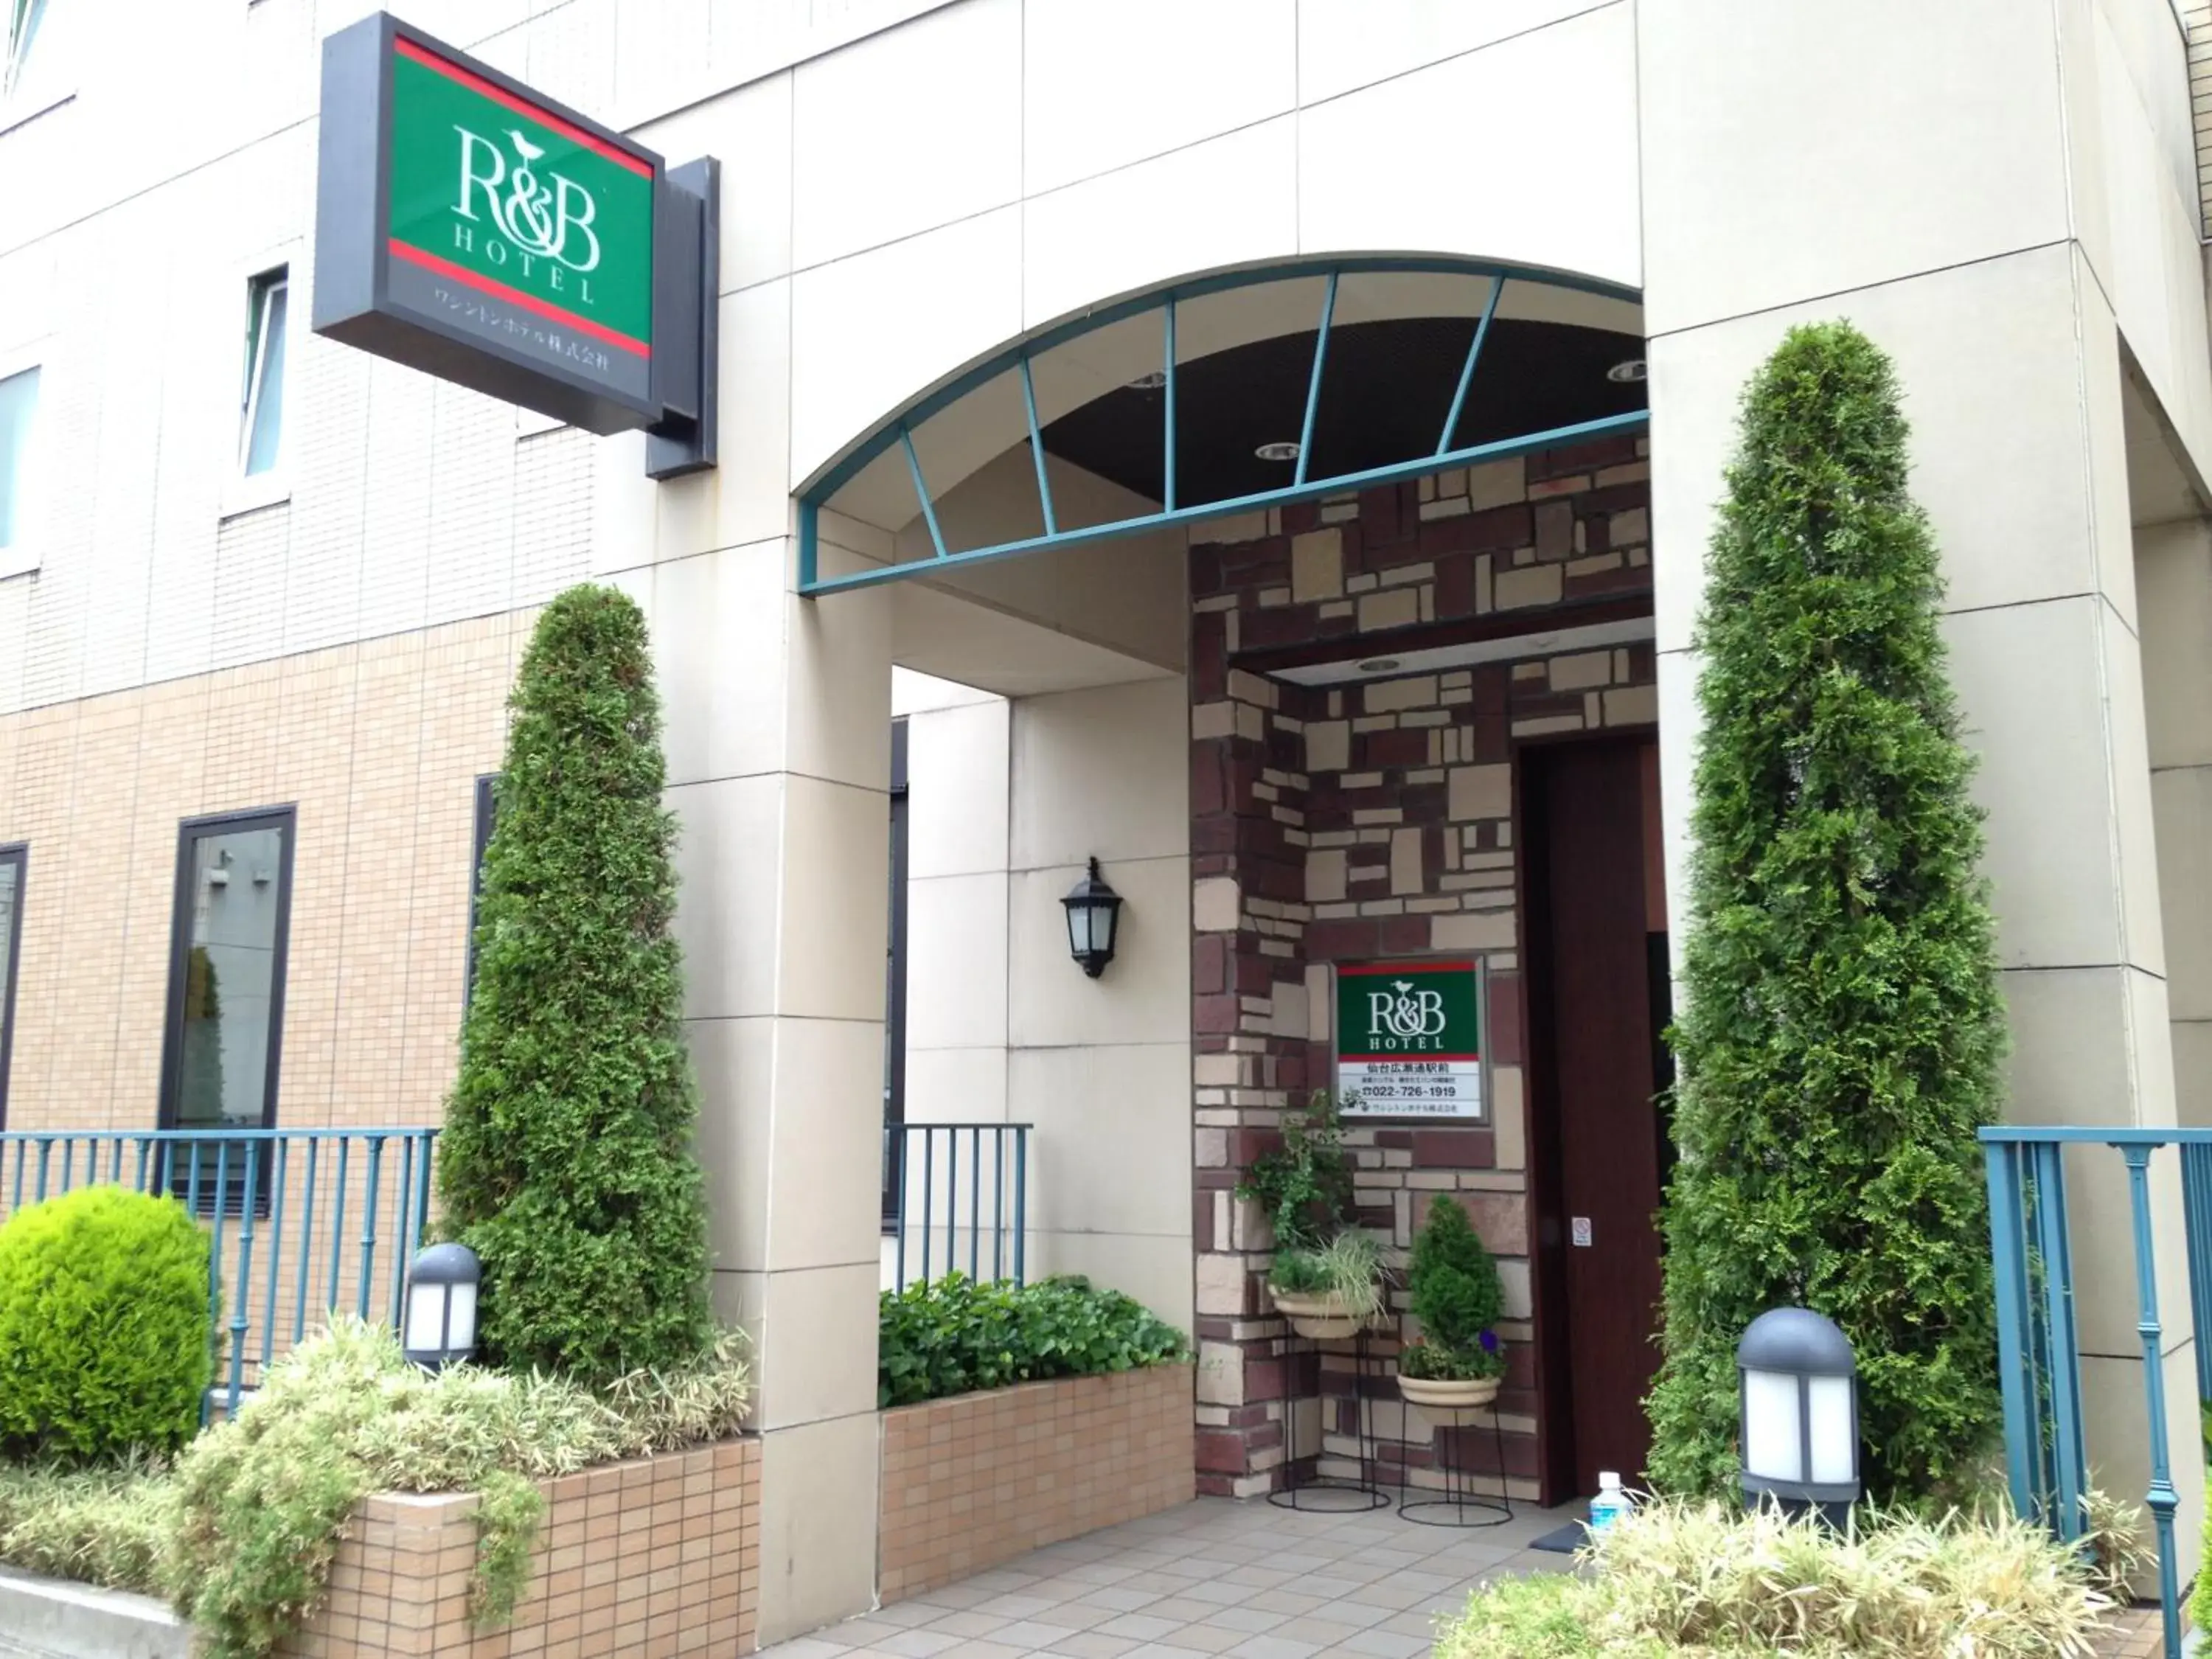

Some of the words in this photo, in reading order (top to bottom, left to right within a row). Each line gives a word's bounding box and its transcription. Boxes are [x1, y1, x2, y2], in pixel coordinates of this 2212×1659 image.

[451, 124, 600, 272] R&B
[455, 223, 594, 305] HOTEL
[434, 286, 611, 372] ワシントンホテル株式会社
[1367, 990, 1446, 1036] R&B
[1369, 1037, 1444, 1050] HOTEL
